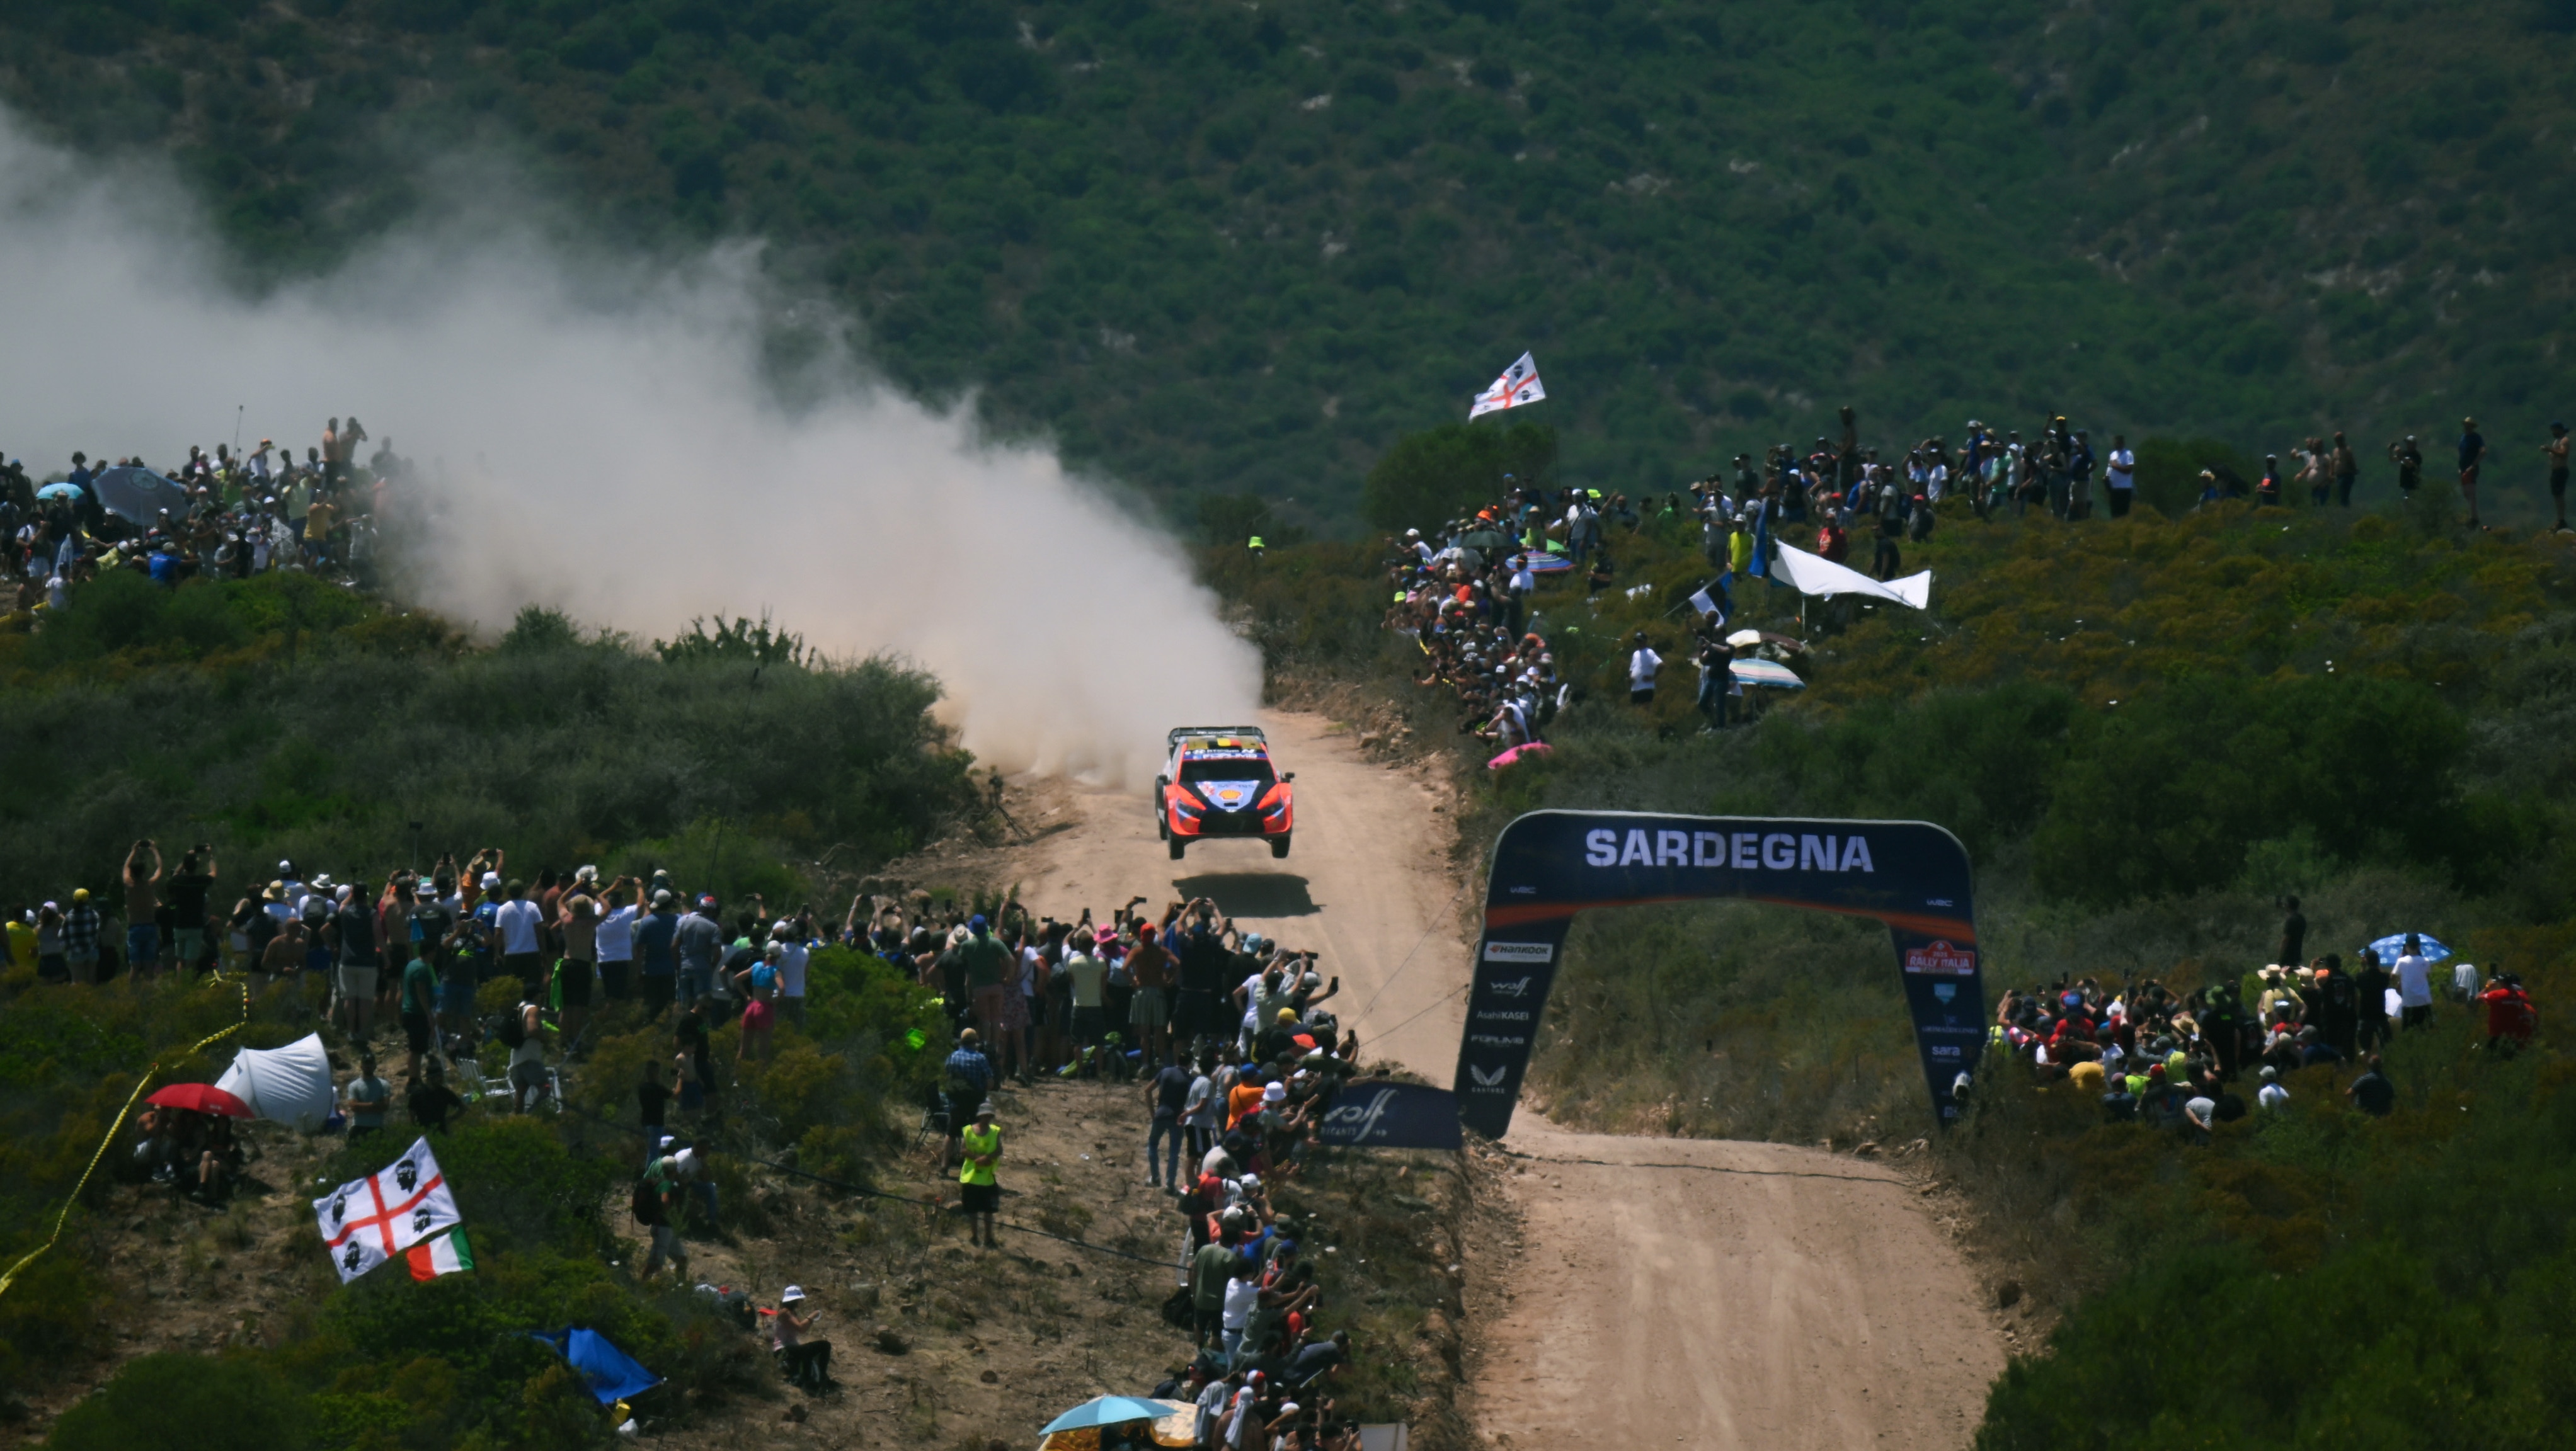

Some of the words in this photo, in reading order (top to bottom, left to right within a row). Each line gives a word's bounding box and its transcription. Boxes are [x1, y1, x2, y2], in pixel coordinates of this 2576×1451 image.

[1585, 829, 1875, 872] SARDEGNA
[1910, 955, 1938, 967] RALLY
[1941, 958, 1970, 968] ITALIA
[1932, 1045, 1961, 1056] sara
